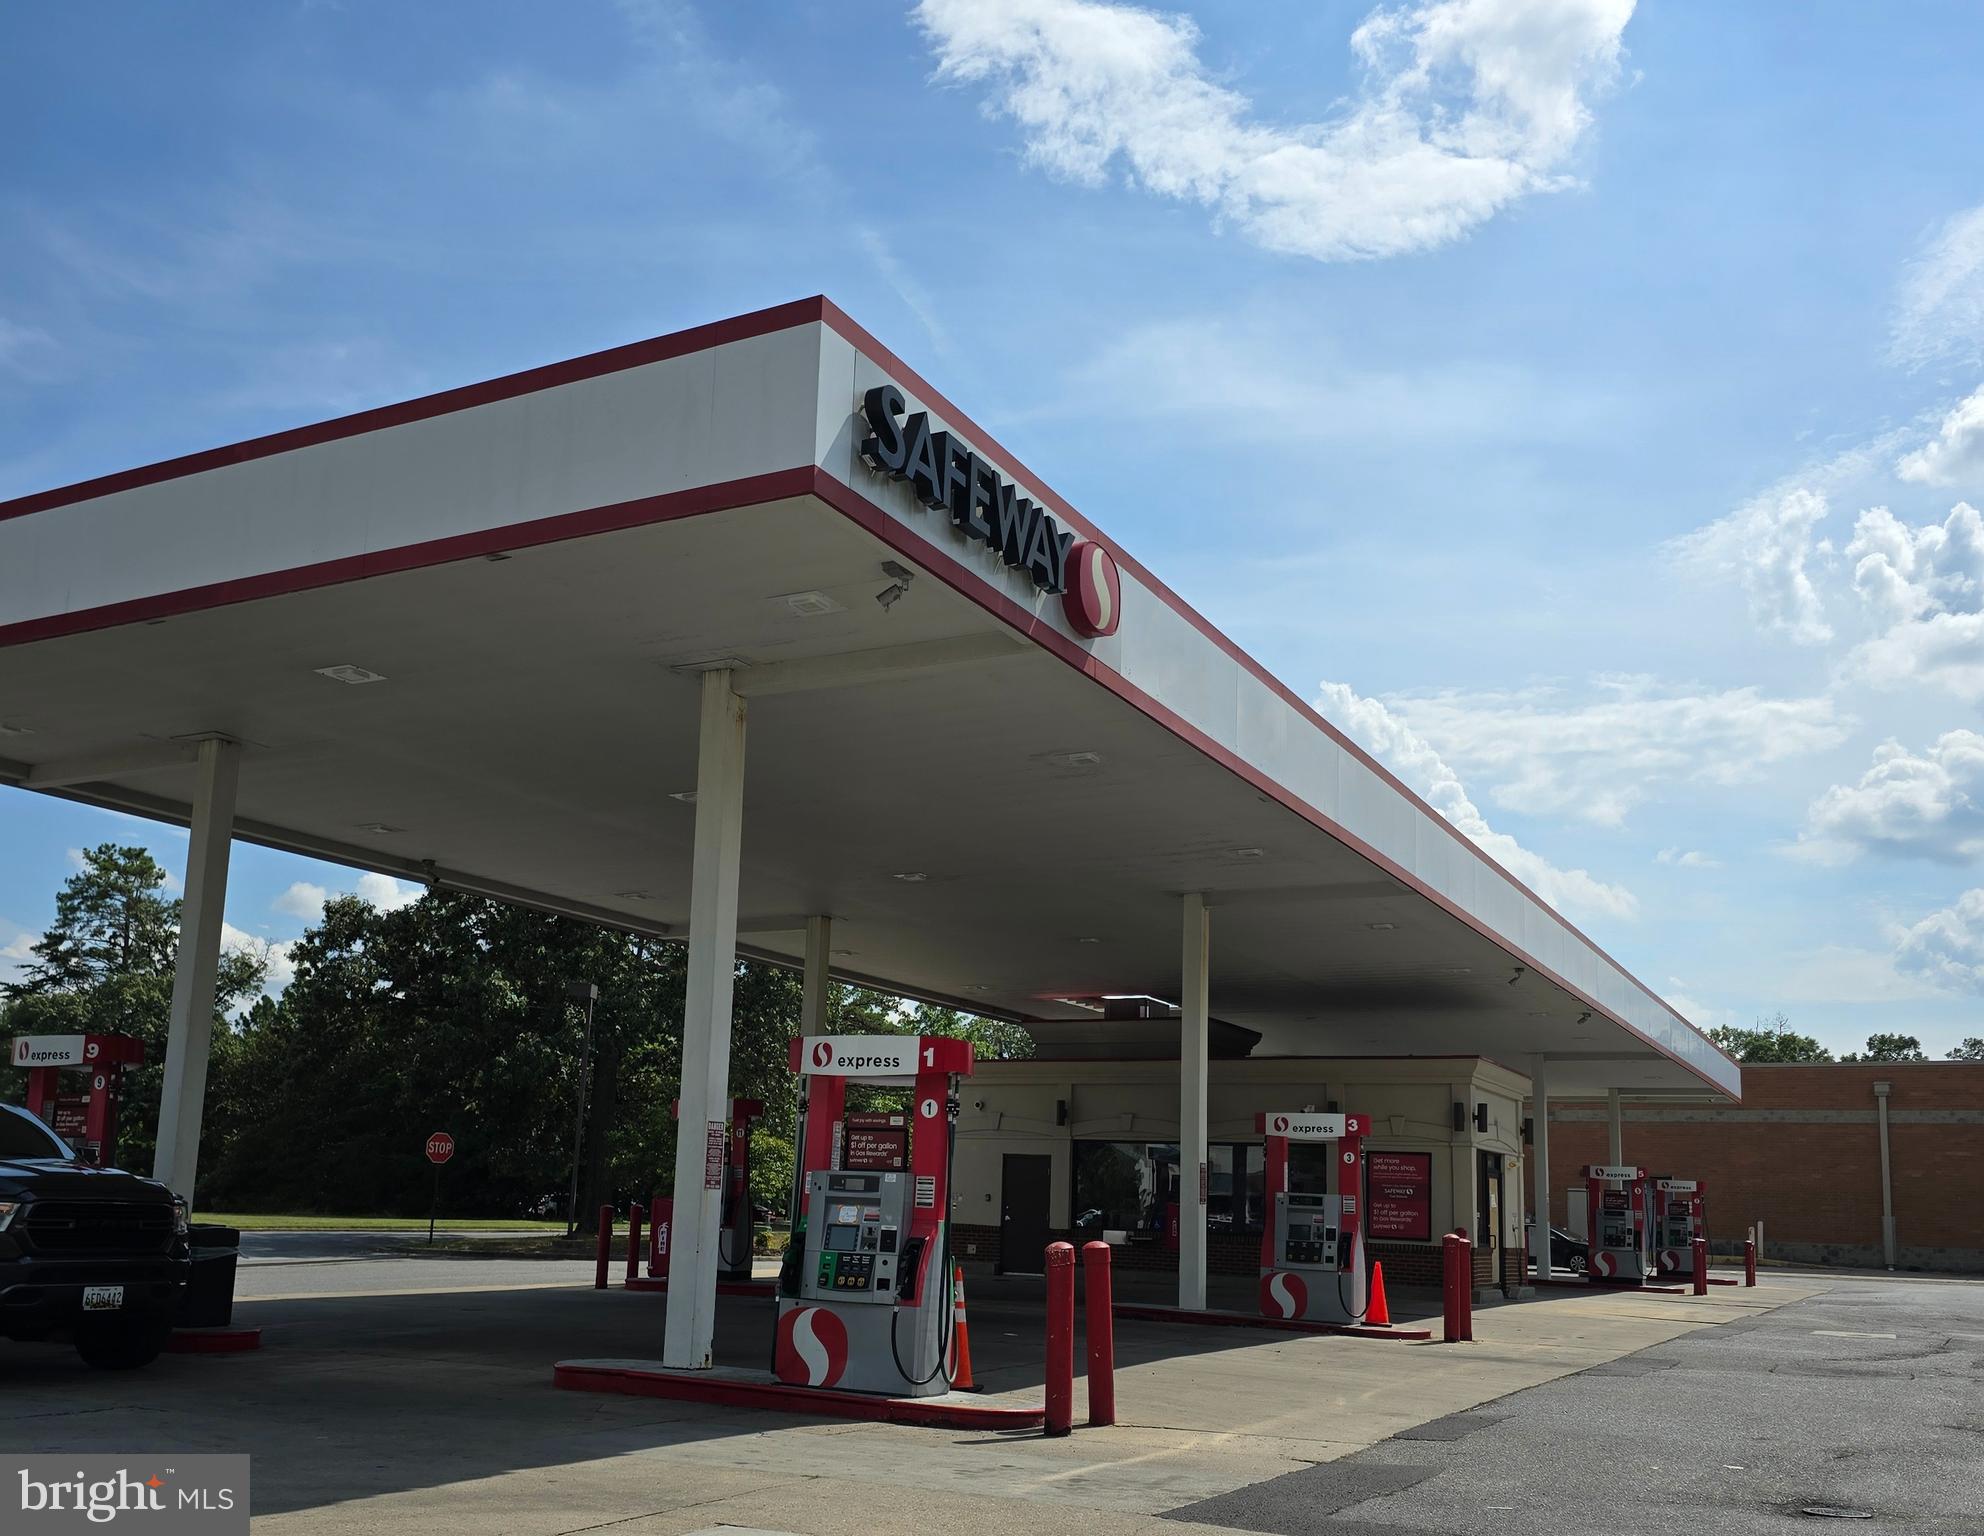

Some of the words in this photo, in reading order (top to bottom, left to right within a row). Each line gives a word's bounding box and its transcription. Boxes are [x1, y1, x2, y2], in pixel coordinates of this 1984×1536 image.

[861, 385, 1075, 595] SAFEWAY
[31, 1050, 71, 1061] express
[86, 1043, 100, 1058] 9
[838, 1056, 900, 1069] express
[923, 1047, 935, 1067] 1
[97, 1077, 102, 1088] 9
[926, 1101, 932, 1115] 1
[1292, 1125, 1334, 1134] express
[1347, 1119, 1358, 1131] 3
[428, 1141, 452, 1154] STOP
[851, 1141, 857, 1149] $1
[878, 1143, 898, 1151] gallon
[1346, 1153, 1352, 1162] 3
[1638, 1170, 1645, 1178] 5
